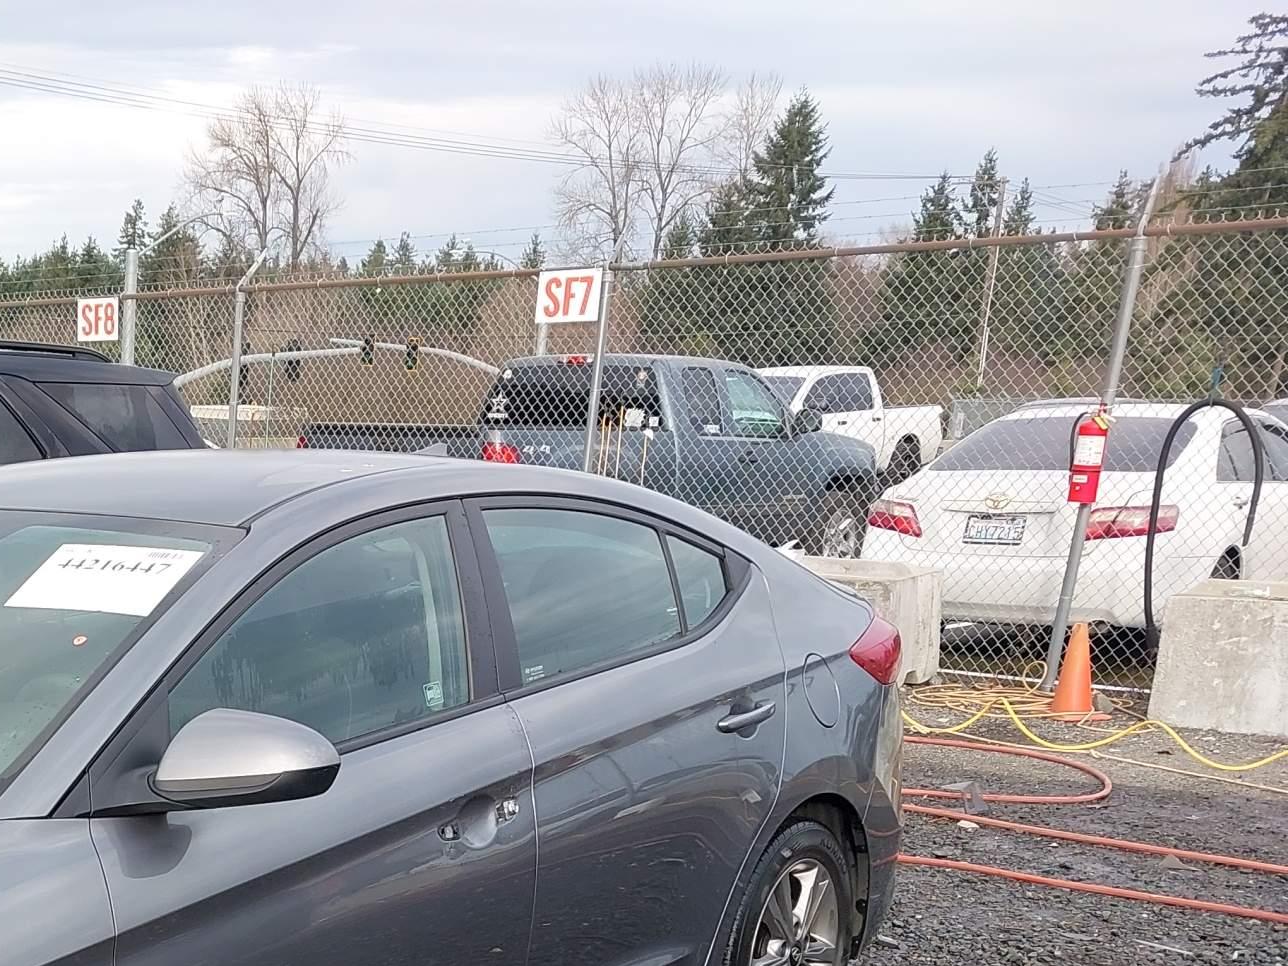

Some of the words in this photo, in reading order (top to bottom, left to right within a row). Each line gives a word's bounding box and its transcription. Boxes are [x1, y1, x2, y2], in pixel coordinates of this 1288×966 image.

[543, 275, 593, 317] SF7
[81, 303, 114, 336] SF8
[58, 557, 172, 574] 44216447
